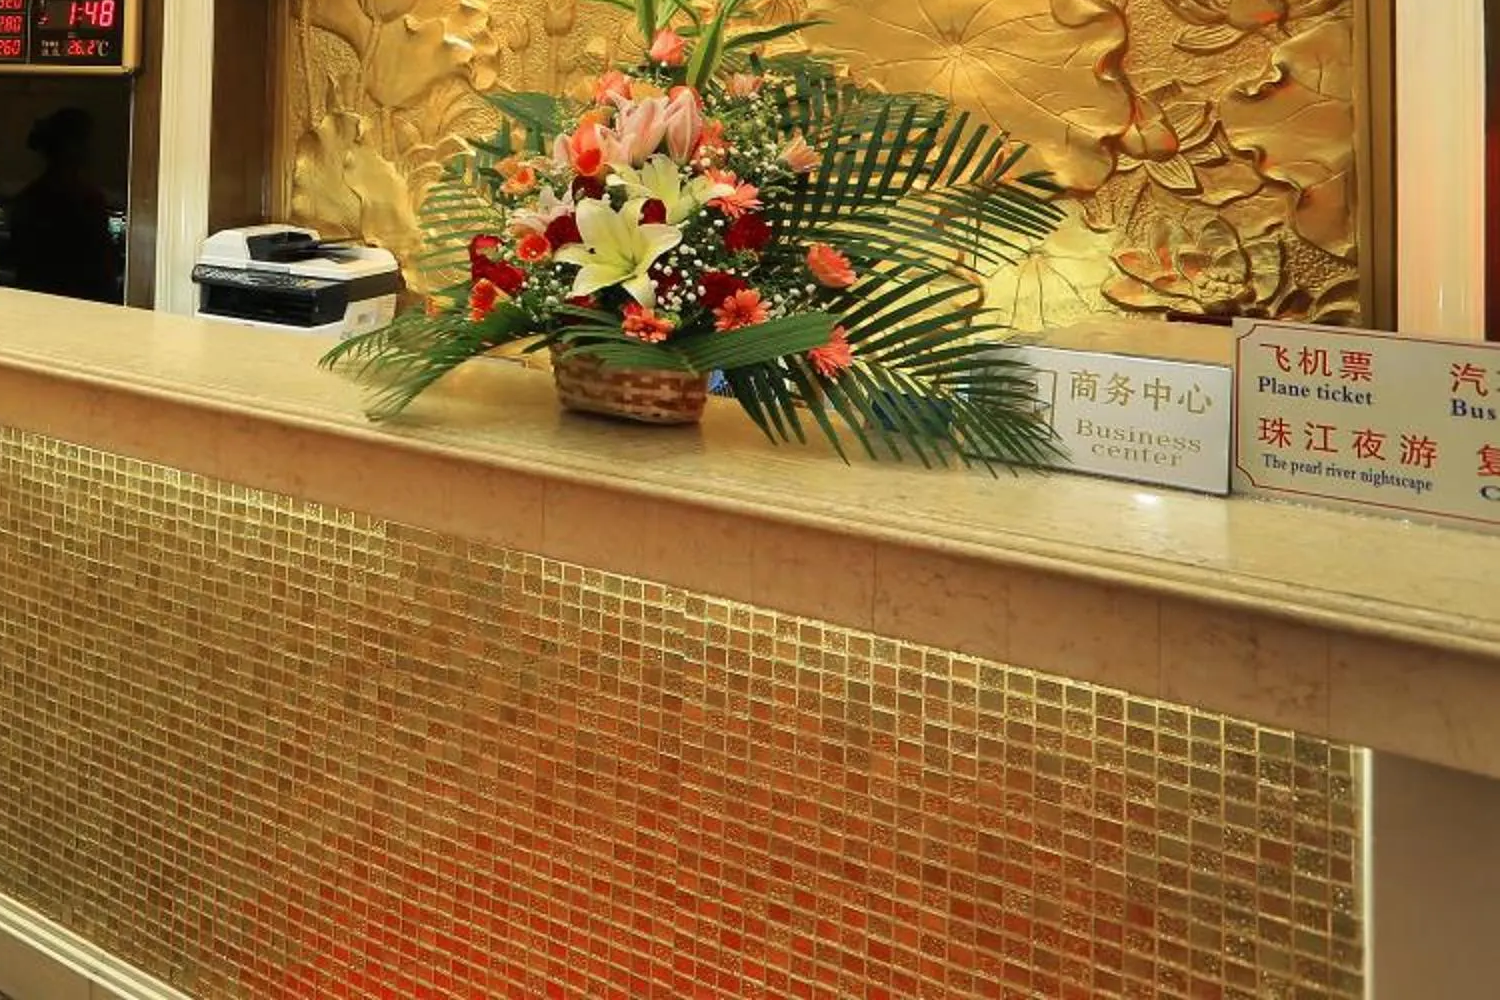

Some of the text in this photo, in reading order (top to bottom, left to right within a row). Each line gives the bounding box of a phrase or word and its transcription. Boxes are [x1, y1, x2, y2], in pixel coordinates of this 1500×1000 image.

[68, 0, 115, 27] 1:48
[1258, 342, 1374, 383] 飞机票
[1449, 362, 1500, 398] 汽
[1068, 368, 1213, 415] 商务中心
[1257, 375, 1374, 406] Plane ticket
[1450, 397, 1497, 421] Bus
[1075, 417, 1202, 453] Business
[1257, 416, 1438, 470] 珠江夜游
[1091, 443, 1183, 467] center
[1261, 452, 1434, 495] The pearl river nightscape
